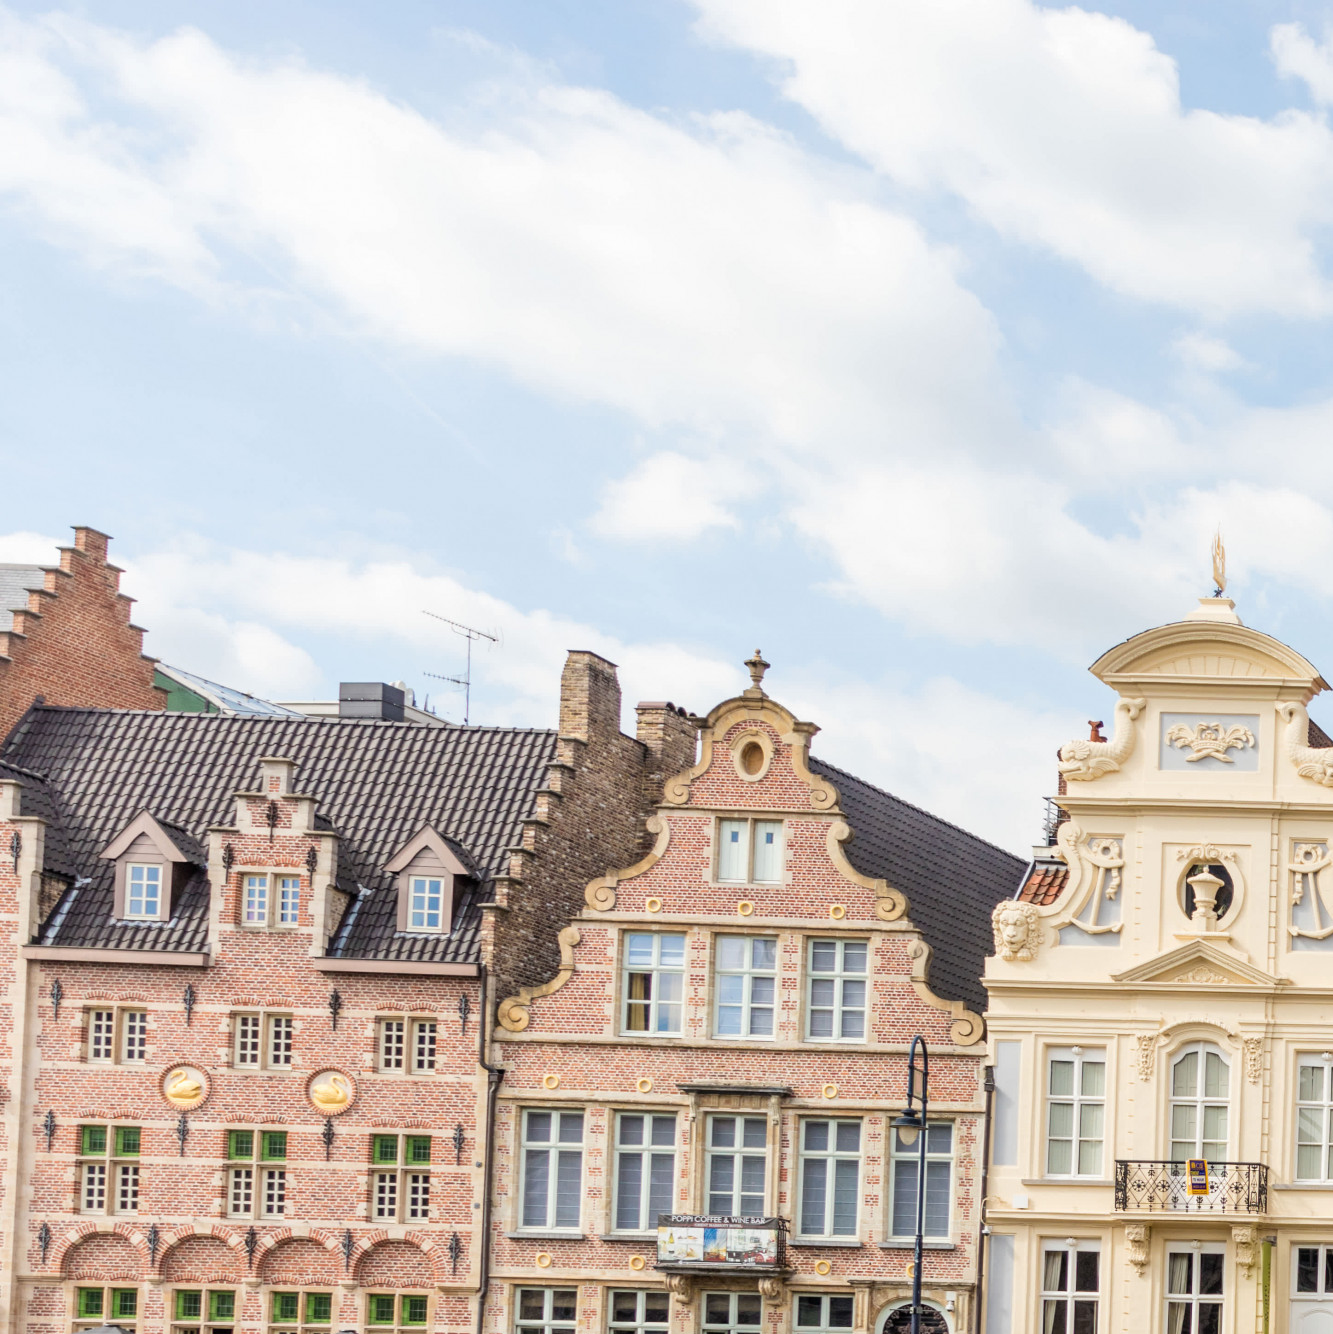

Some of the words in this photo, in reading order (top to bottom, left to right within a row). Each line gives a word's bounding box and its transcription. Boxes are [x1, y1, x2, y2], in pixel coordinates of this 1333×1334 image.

[723, 1216, 729, 1224] &
[731, 1216, 750, 1224] WINE
[751, 1217, 766, 1225] BAR
